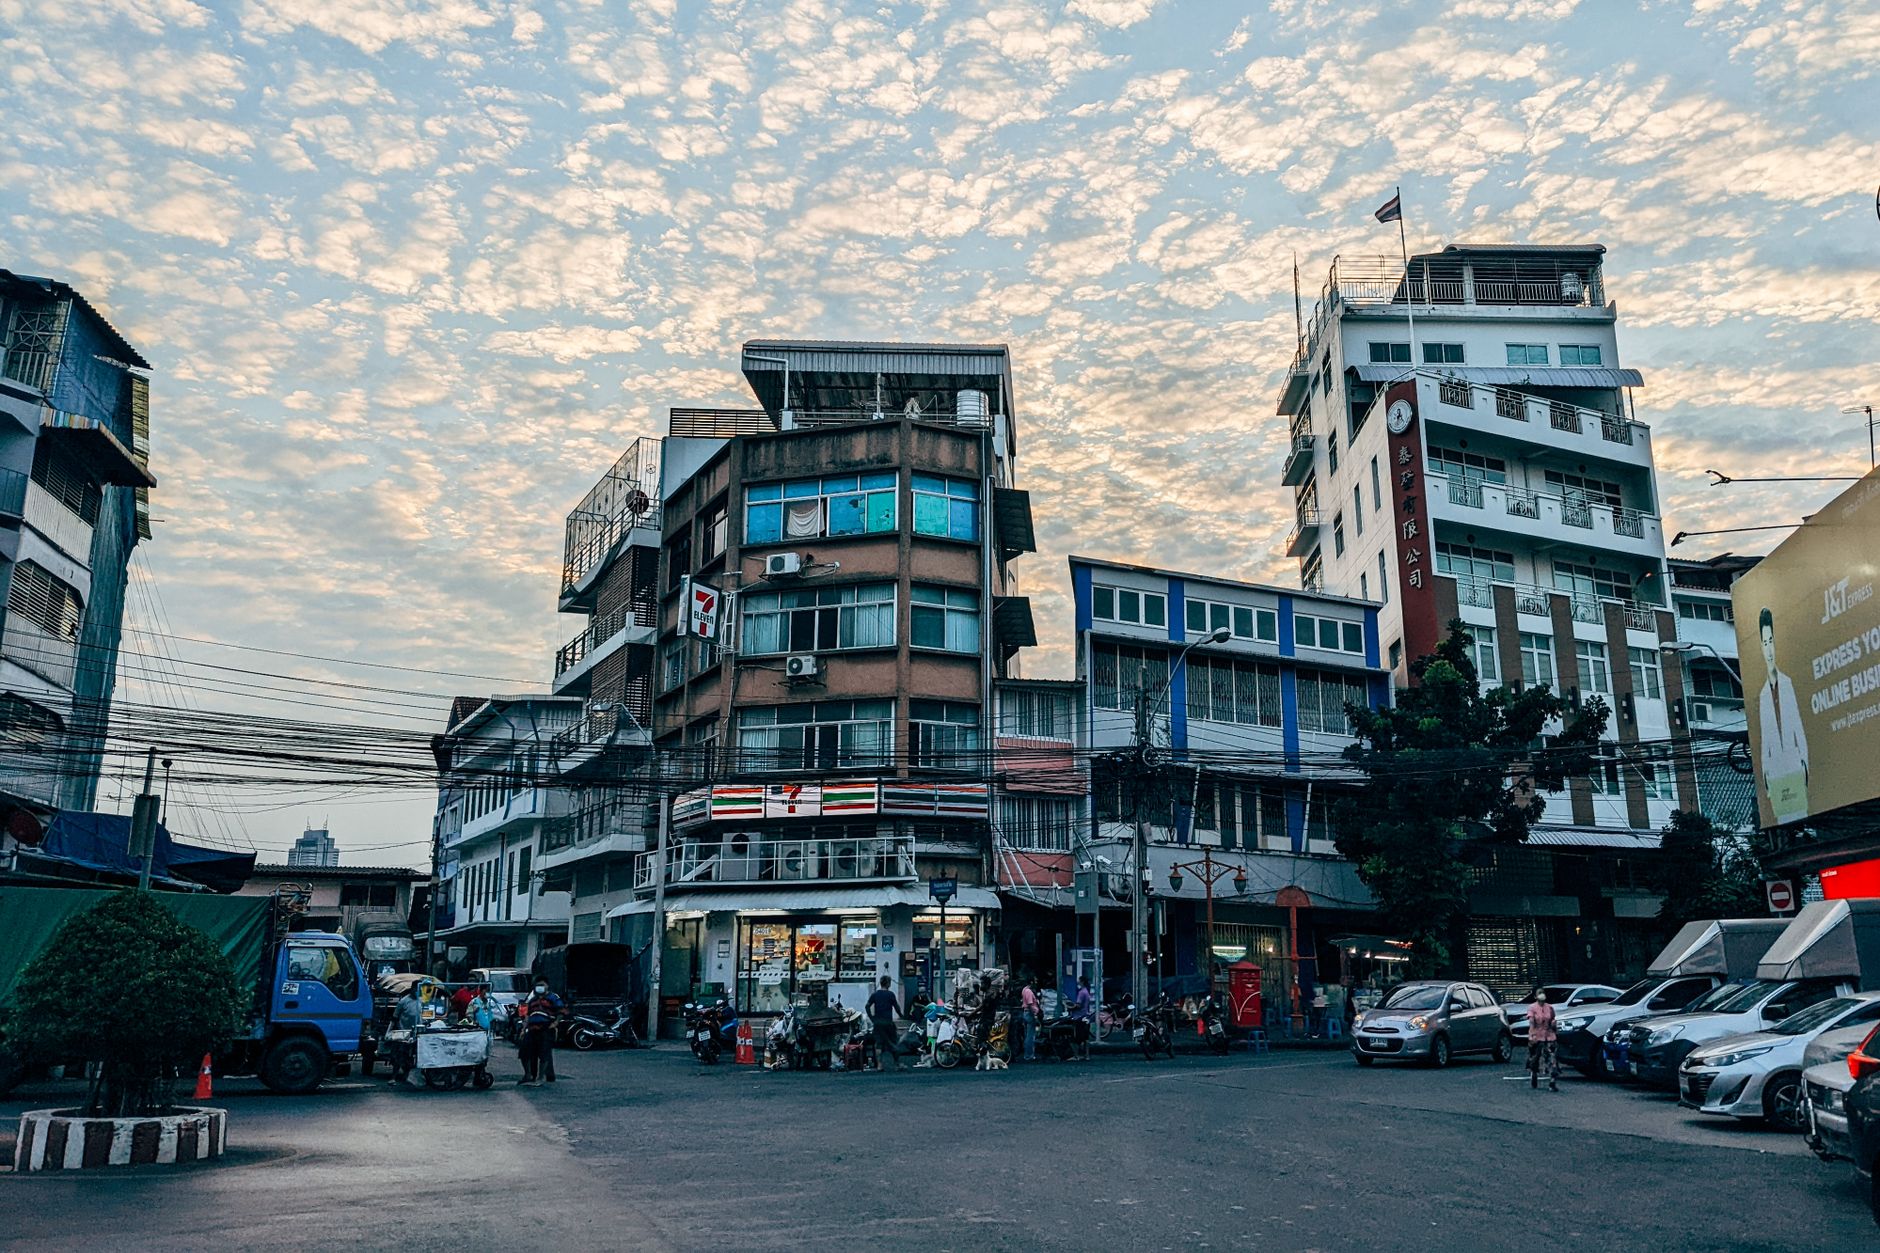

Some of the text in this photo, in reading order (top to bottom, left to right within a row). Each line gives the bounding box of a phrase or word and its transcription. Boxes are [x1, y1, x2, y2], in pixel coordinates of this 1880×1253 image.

[695, 590, 715, 637] 7
[1821, 576, 1873, 624] J&T EXPRESS
[1812, 625, 1880, 680] EXPRESS YO
[1811, 679, 1851, 714] ONLINE
